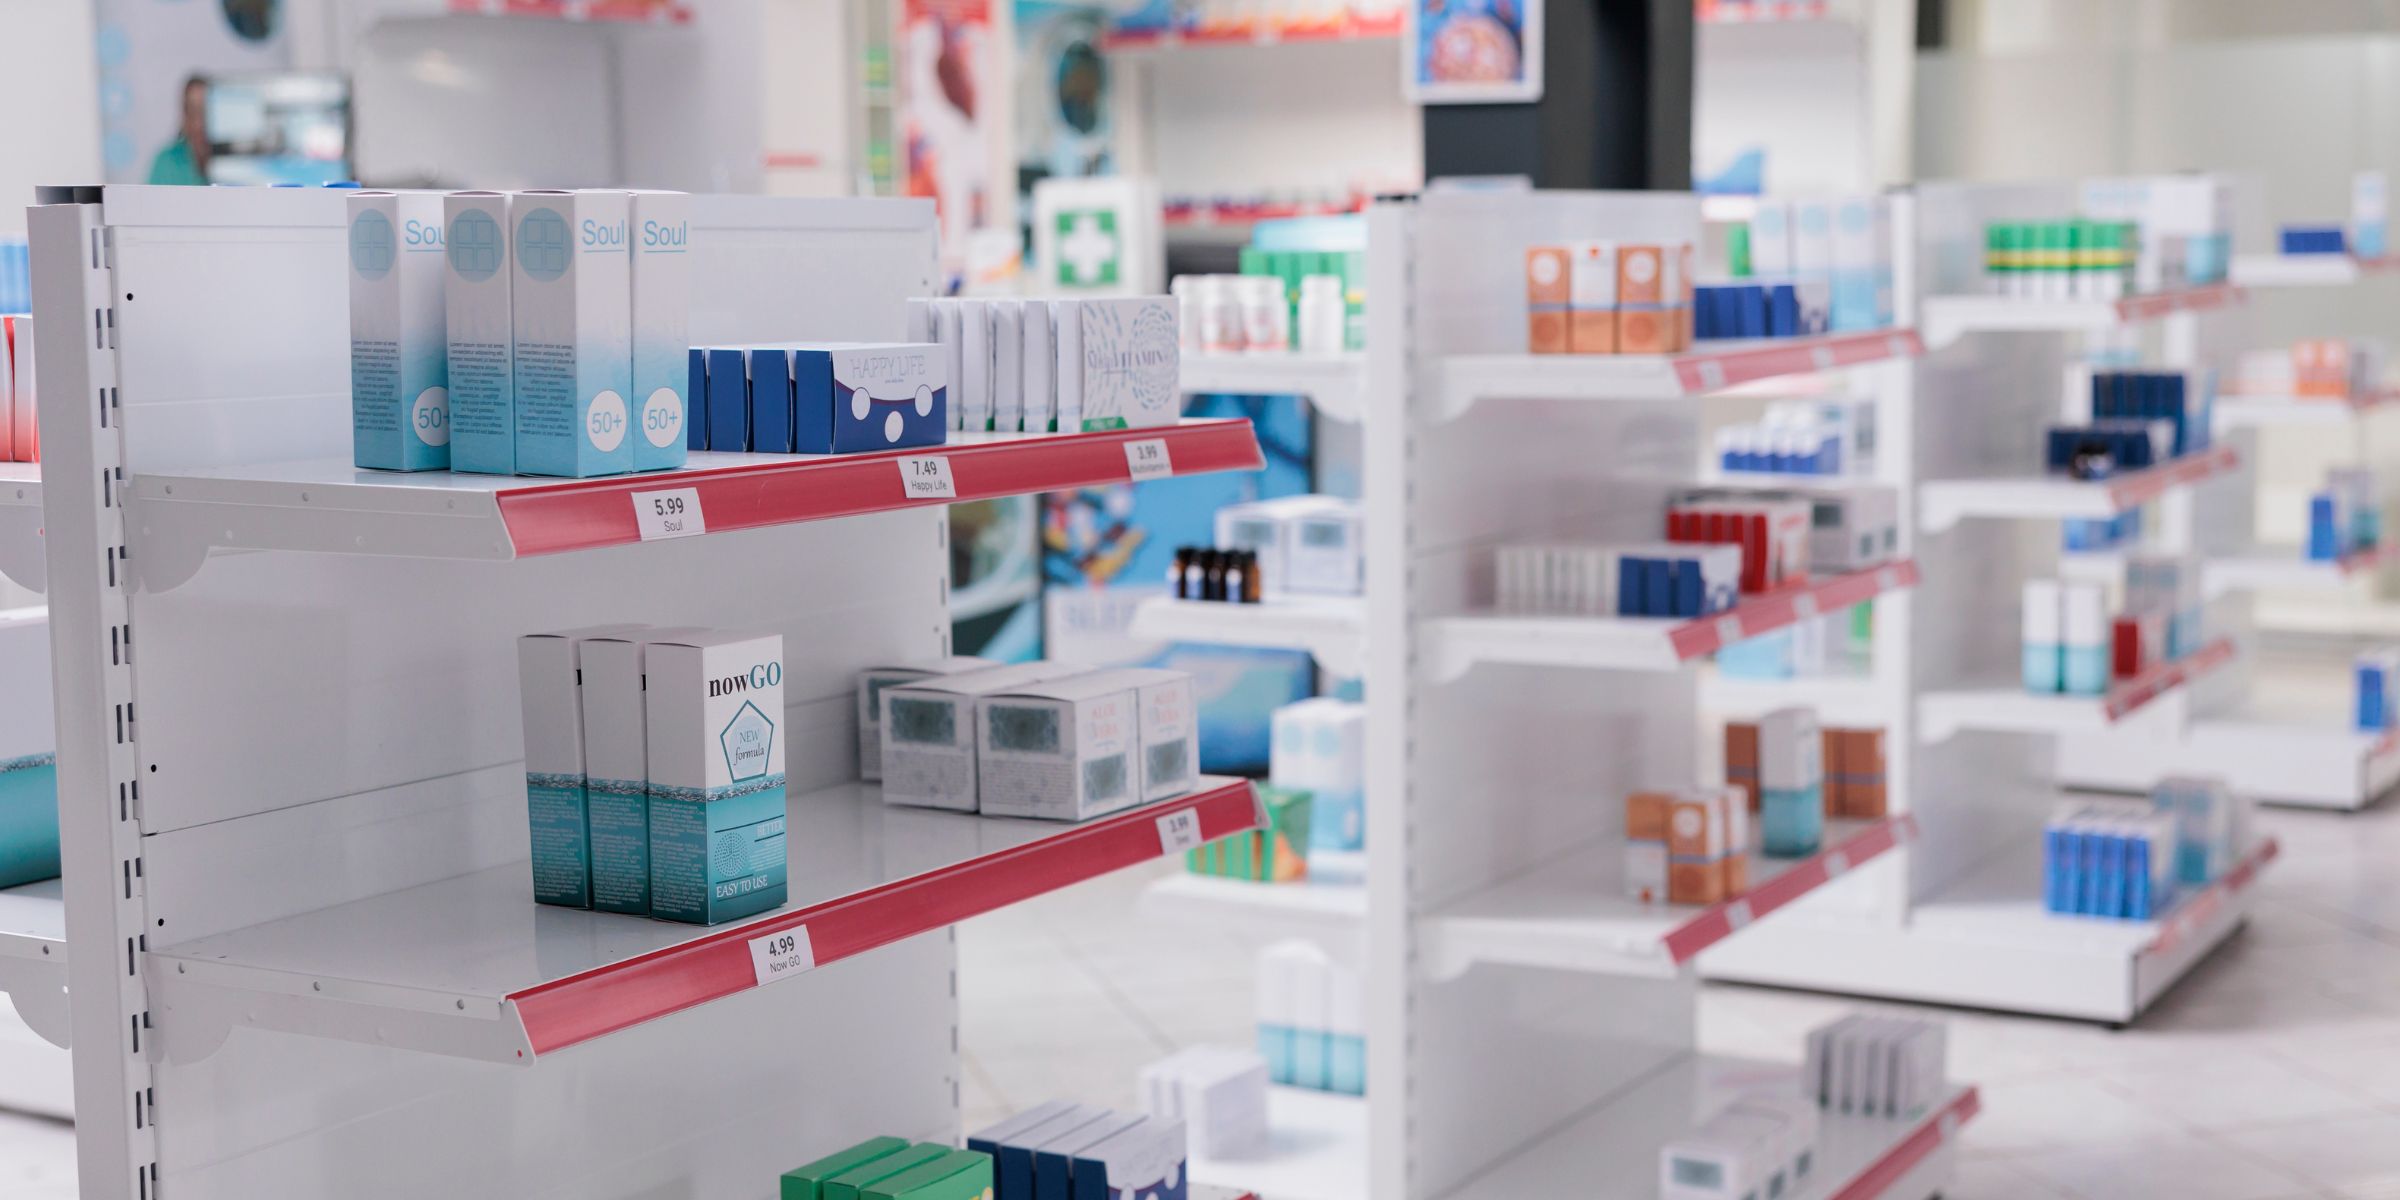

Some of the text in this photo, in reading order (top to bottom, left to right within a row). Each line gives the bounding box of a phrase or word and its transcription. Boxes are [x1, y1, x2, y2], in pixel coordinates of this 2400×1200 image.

[405, 219, 446, 245] Sou
[582, 218, 625, 246] Soul
[643, 219, 687, 246] Soul
[850, 354, 926, 379] HAPPY LIFE
[592, 411, 622, 434] 50+
[647, 408, 678, 430] 50+
[1136, 445, 1158, 460] 3.99
[912, 461, 938, 475] 7.49
[911, 478, 948, 493] Happy Life
[654, 497, 684, 516] 5.99
[664, 519, 684, 532] Soul
[708, 661, 782, 698] nowGO
[740, 728, 760, 742] NEW
[733, 742, 765, 766] formula
[756, 819, 784, 837] BETTER
[716, 875, 768, 898] EASY TO USE
[769, 935, 795, 956] 4.99
[769, 954, 801, 973] Now GO
